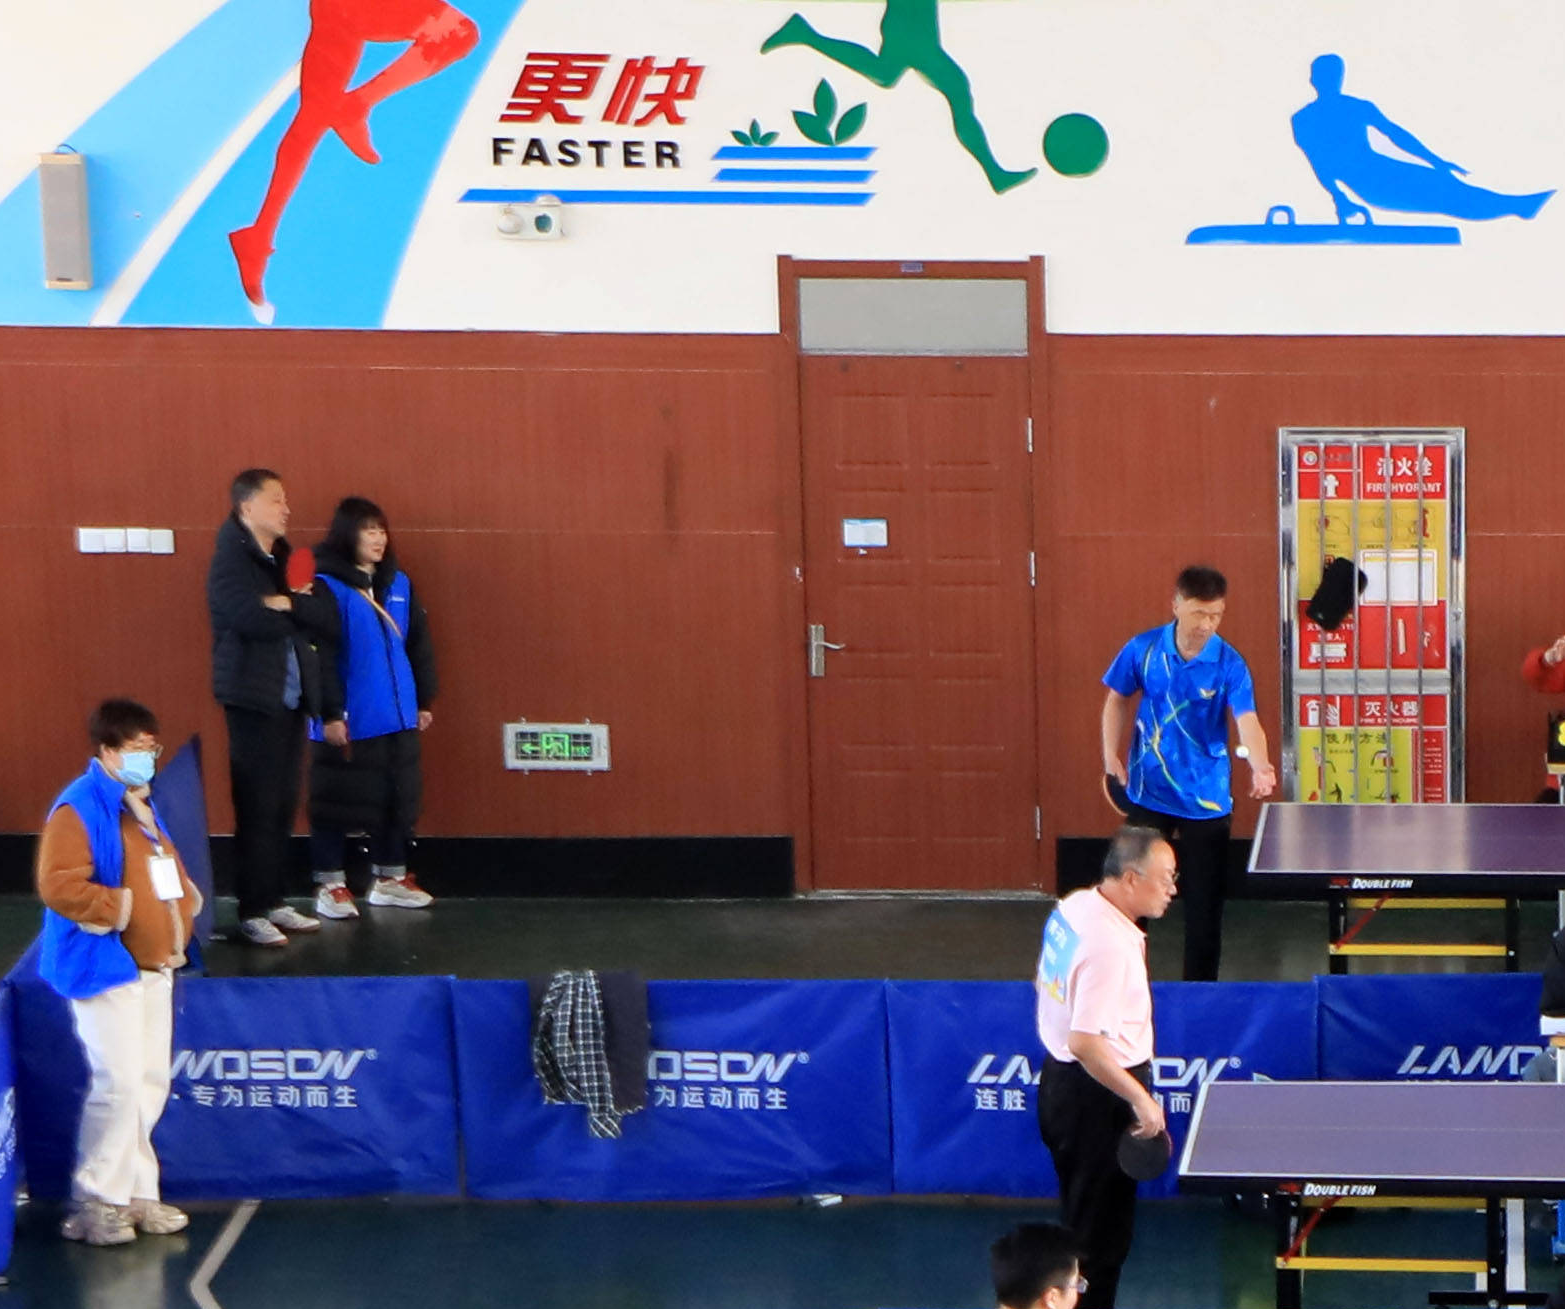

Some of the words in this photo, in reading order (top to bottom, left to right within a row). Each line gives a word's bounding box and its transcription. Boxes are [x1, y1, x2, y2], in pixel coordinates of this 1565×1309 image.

[499, 52, 705, 126] 更快
[492, 137, 680, 168] FASTER
[172, 1049, 366, 1080] NDSON
[647, 1050, 797, 1082] DSON
[172, 1084, 358, 1109] ·专为运动而生
[653, 1085, 789, 1110] 为运动而生
[1303, 1182, 1350, 1196] DOUBLE
[1350, 1185, 1377, 1196] FISH
